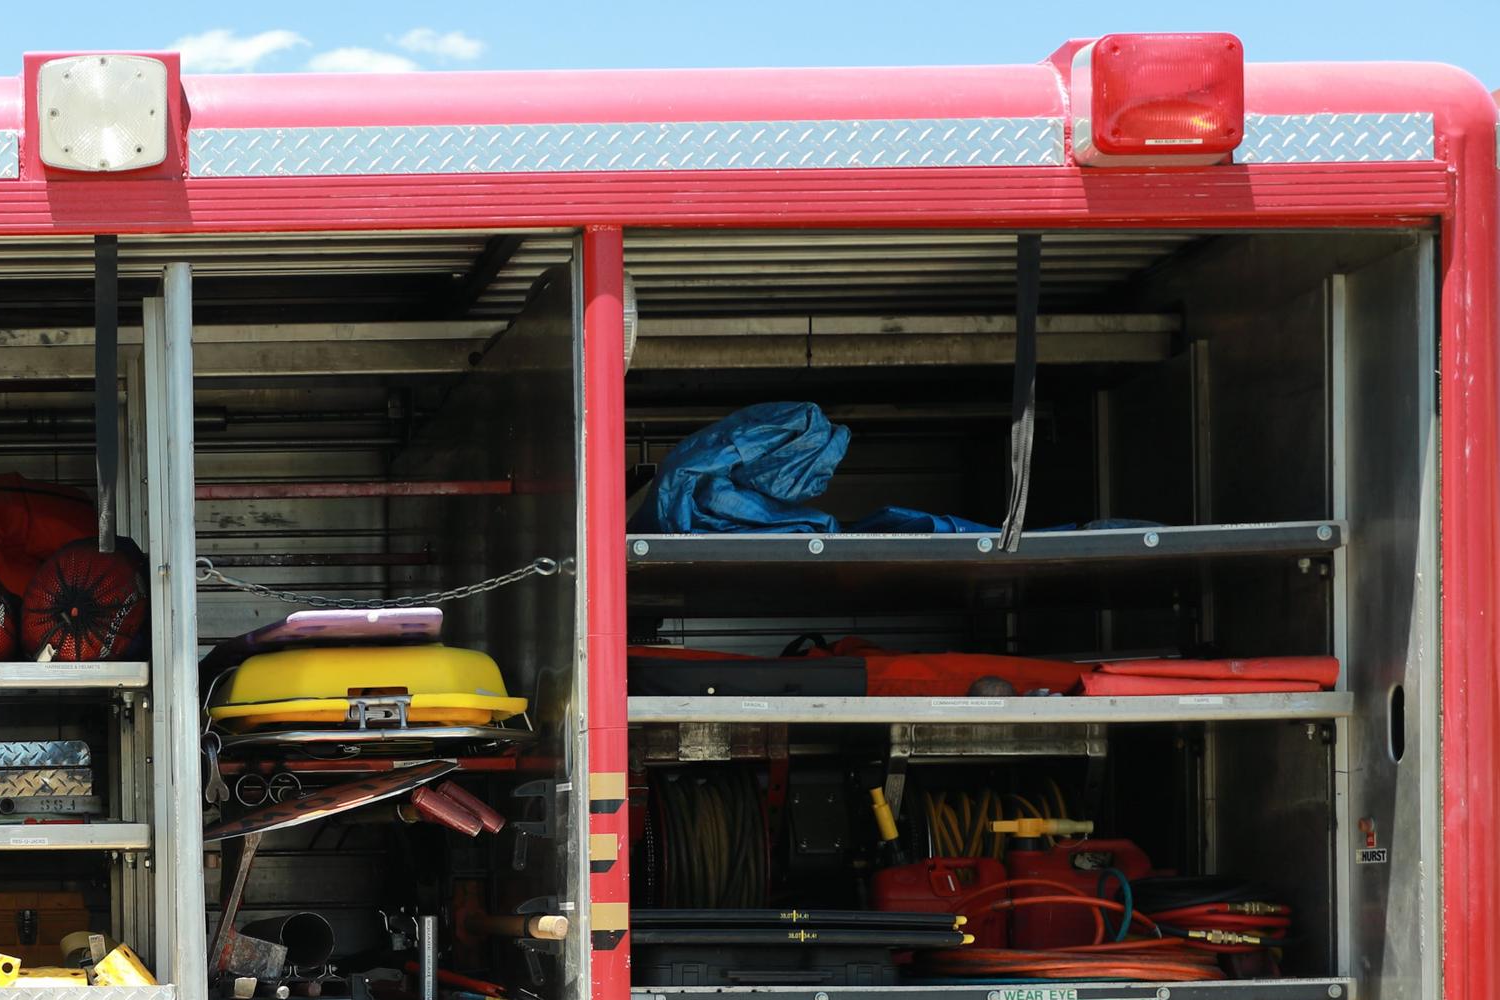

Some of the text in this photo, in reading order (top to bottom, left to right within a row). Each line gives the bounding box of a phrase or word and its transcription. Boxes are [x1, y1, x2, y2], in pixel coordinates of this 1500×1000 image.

[1362, 850, 1386, 862] HURST
[1004, 989, 1076, 1000] WEAR EYE
